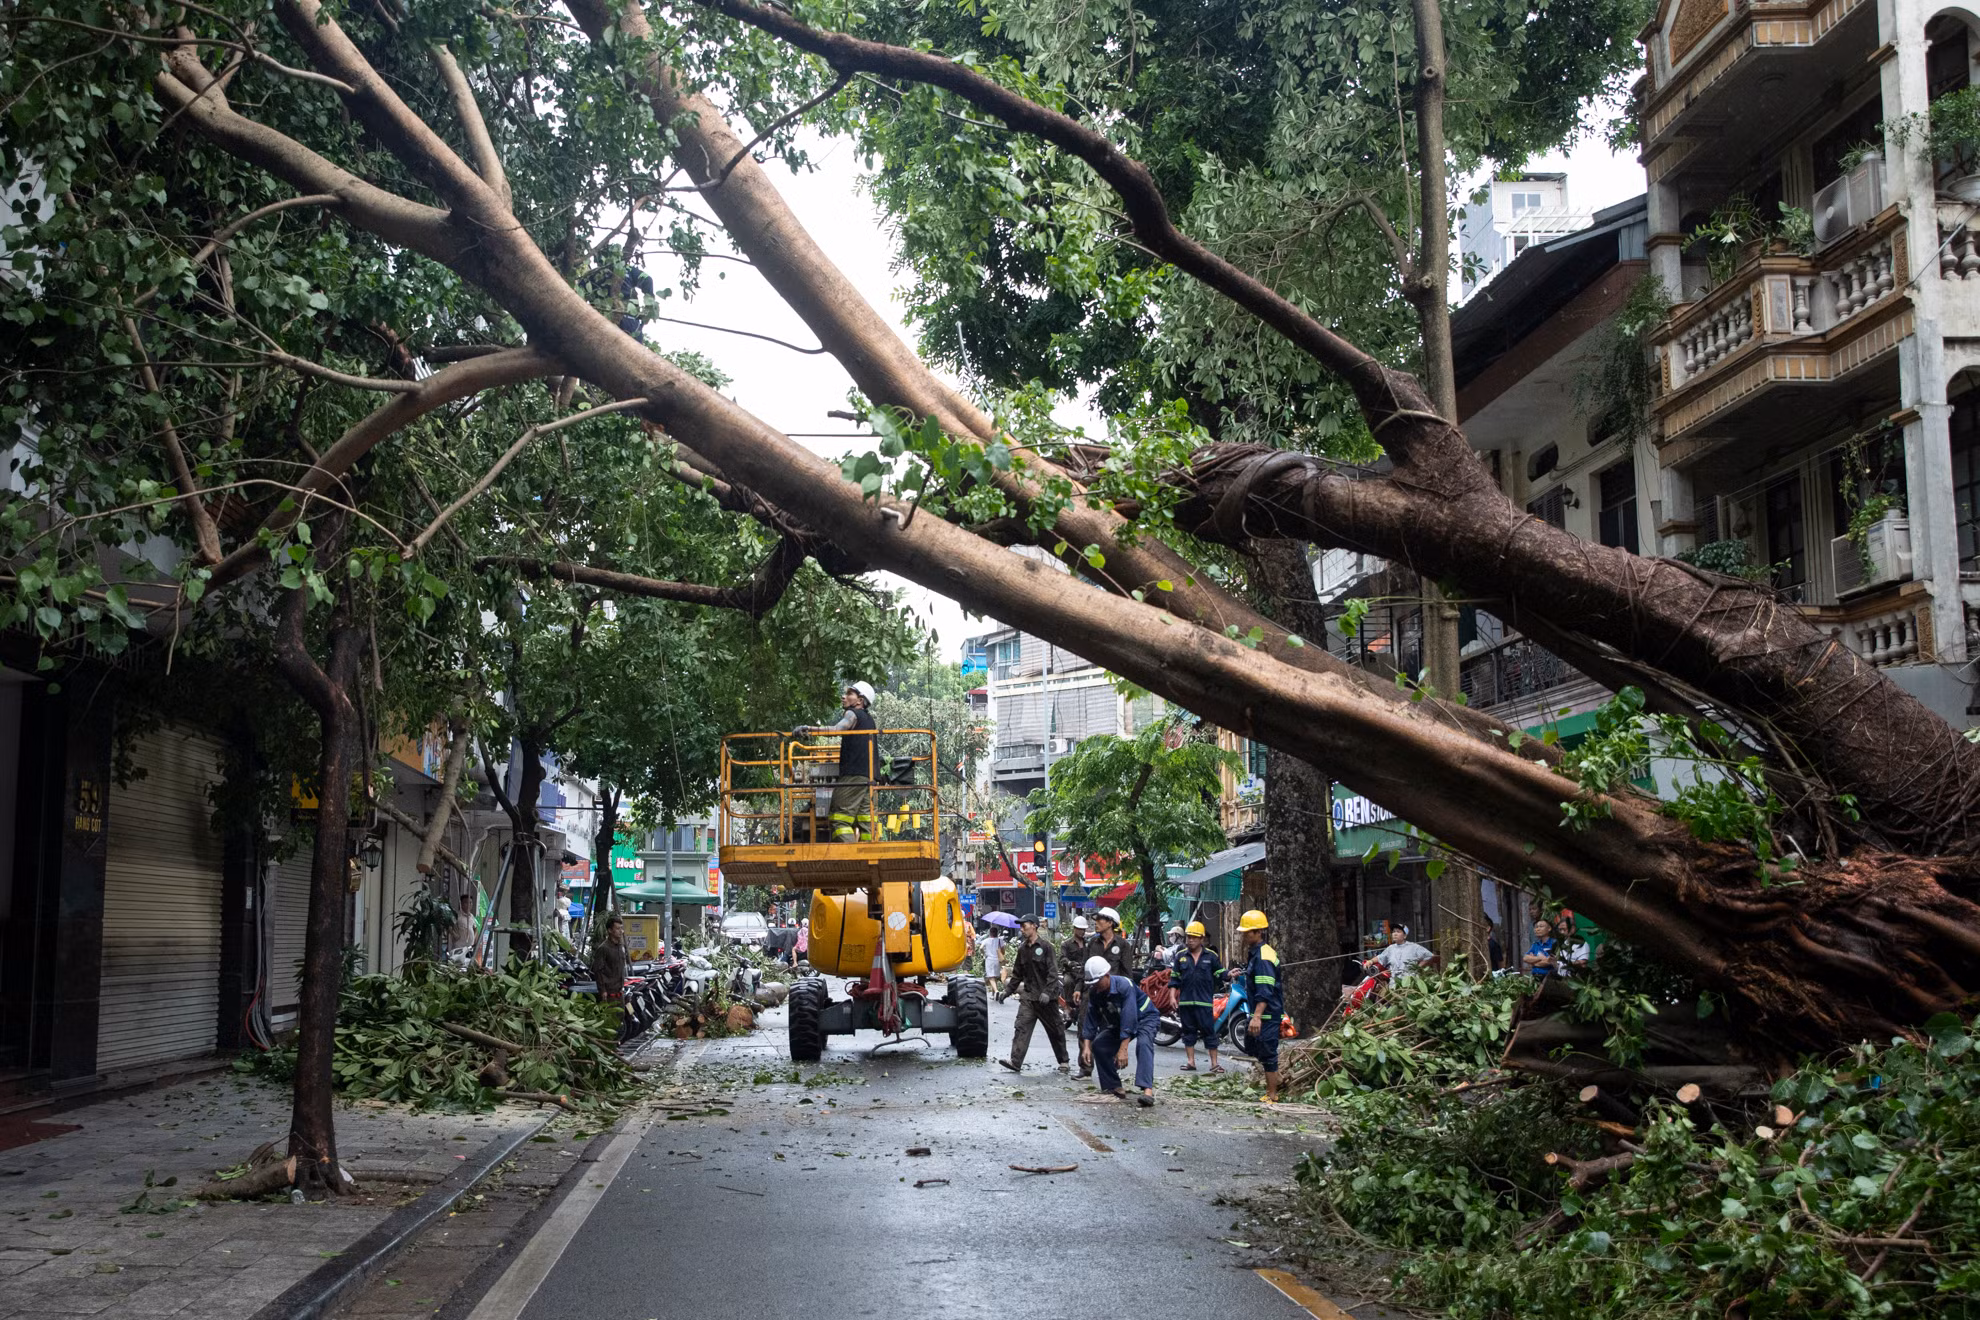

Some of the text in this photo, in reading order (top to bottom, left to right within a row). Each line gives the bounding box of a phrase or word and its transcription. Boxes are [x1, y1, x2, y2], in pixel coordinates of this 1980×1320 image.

[79, 779, 102, 813] 59
[75, 813, 90, 831] HÀNG
[1344, 795, 1370, 828] BEN
[616, 858, 634, 868] Hoa
